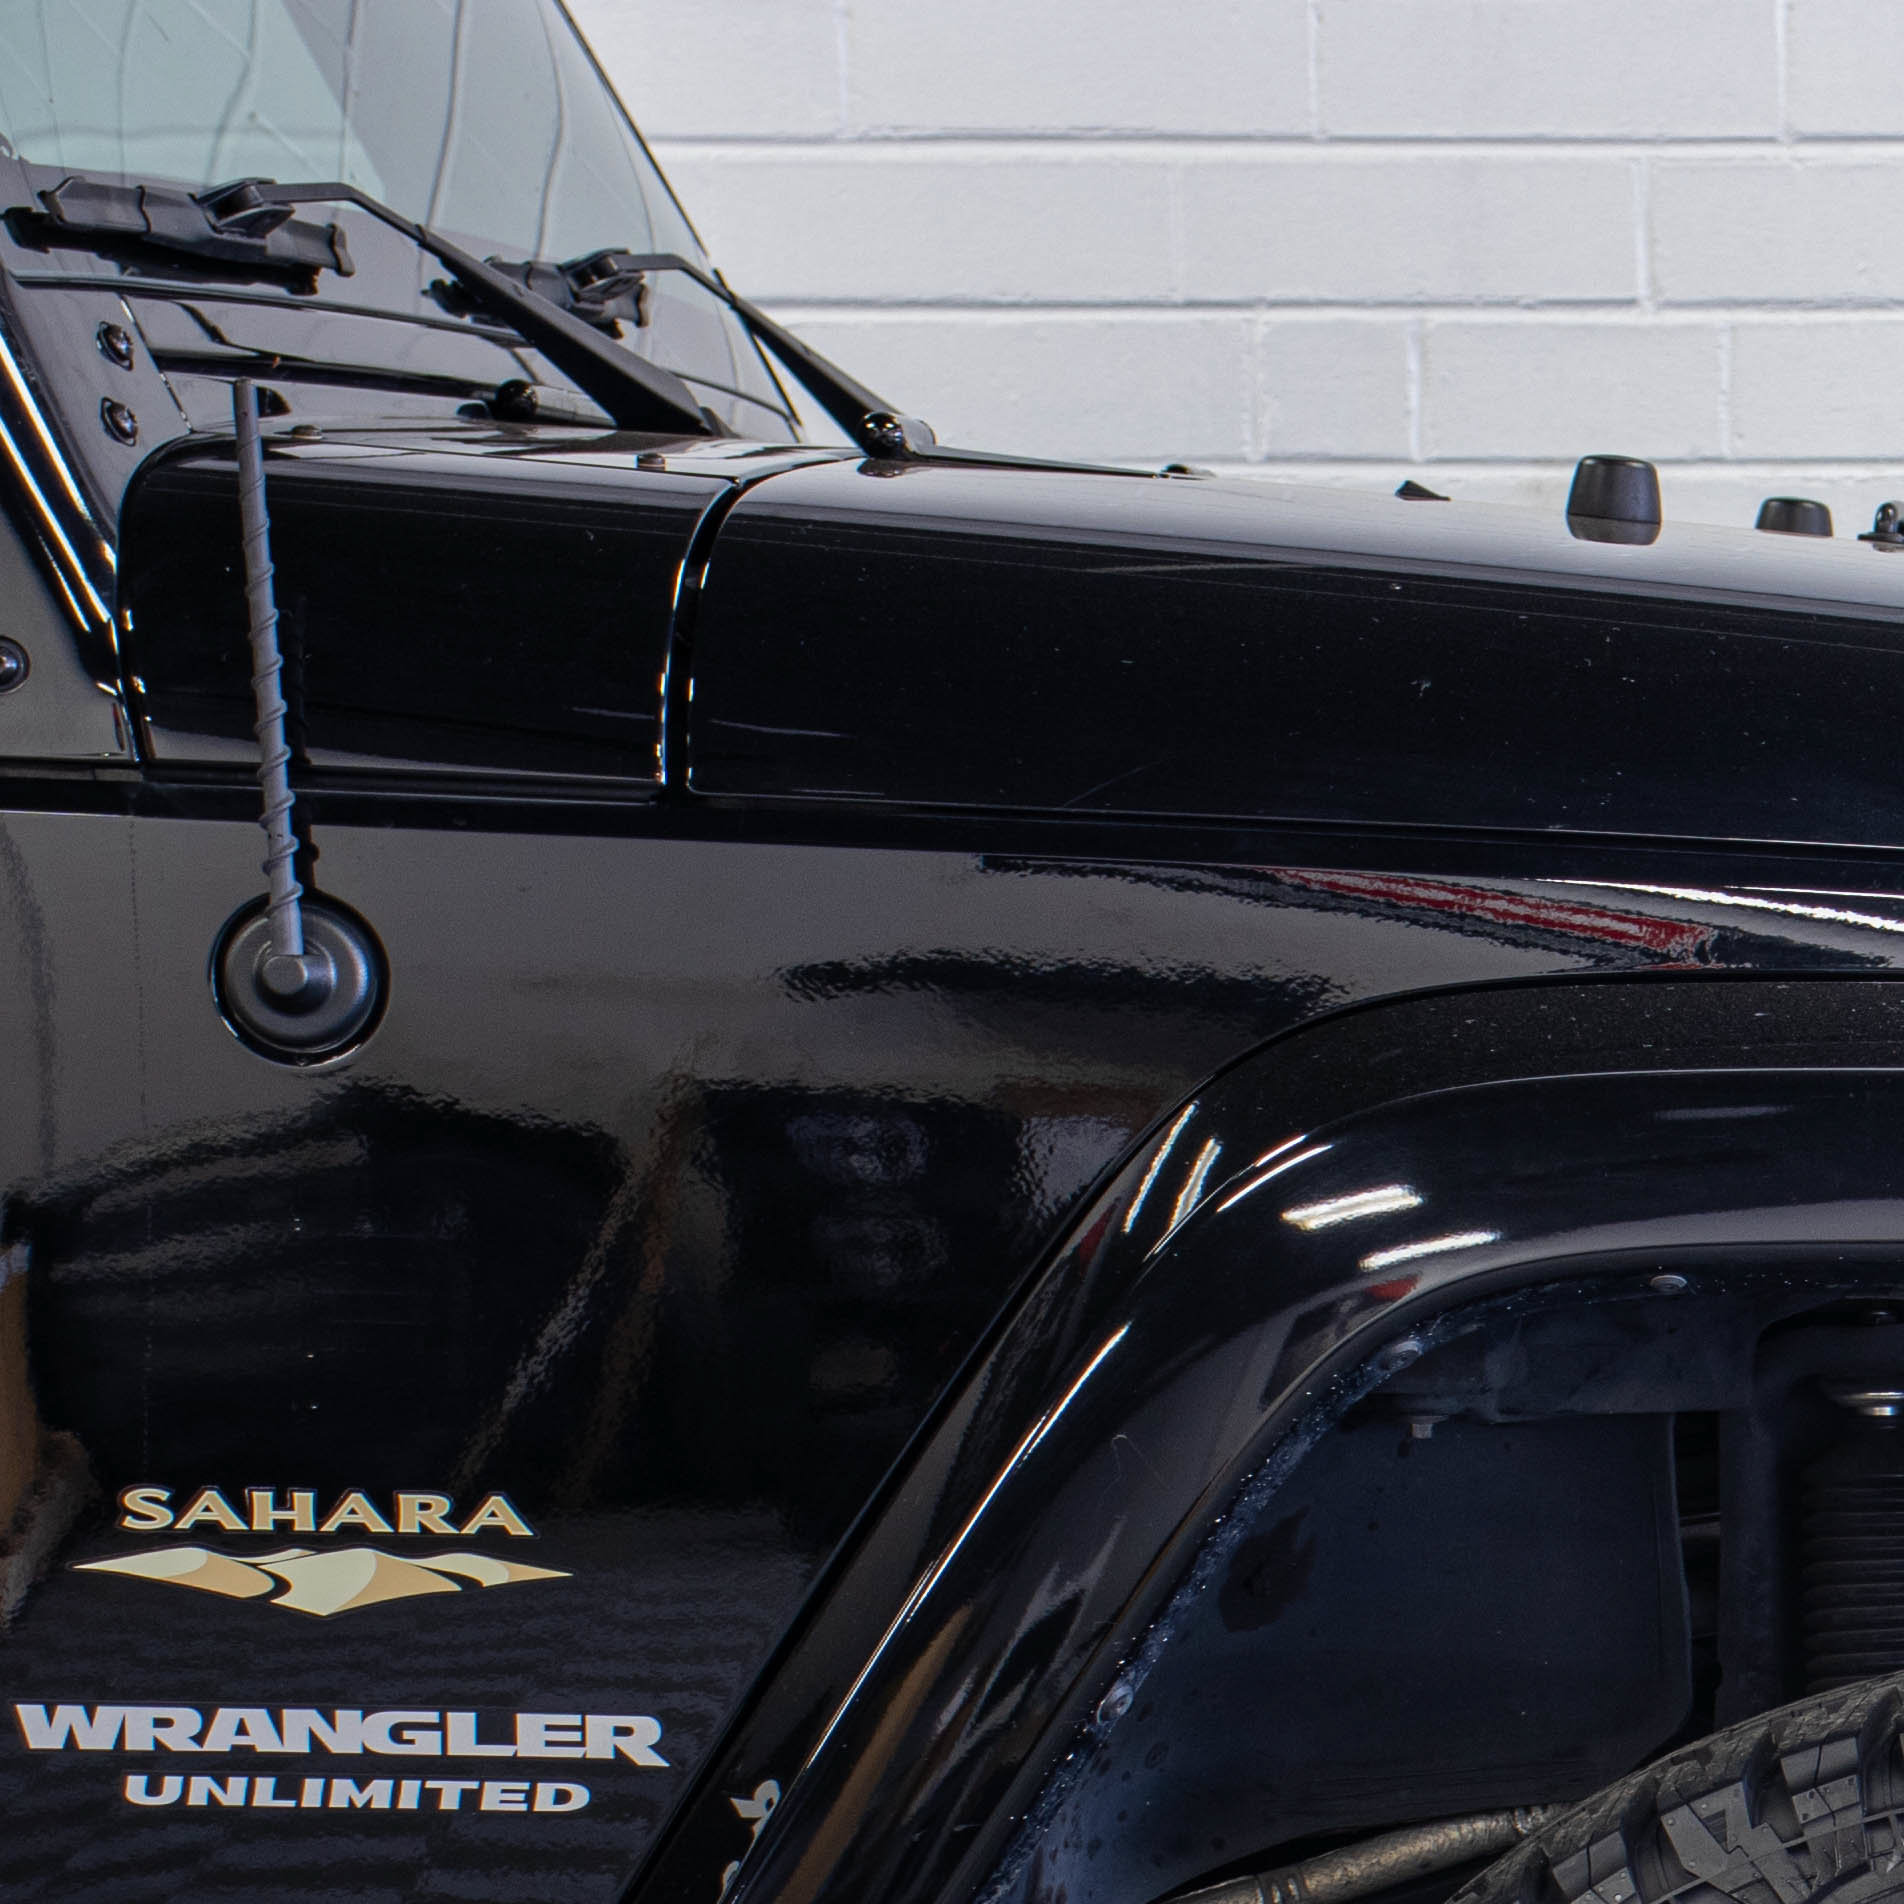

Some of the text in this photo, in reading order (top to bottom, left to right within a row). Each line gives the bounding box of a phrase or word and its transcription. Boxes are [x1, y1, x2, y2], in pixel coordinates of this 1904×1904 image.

[121, 1487, 534, 1536] SAHARA
[16, 1703, 670, 1766] WRANGLER
[124, 1775, 591, 1812] UNLIMITED
